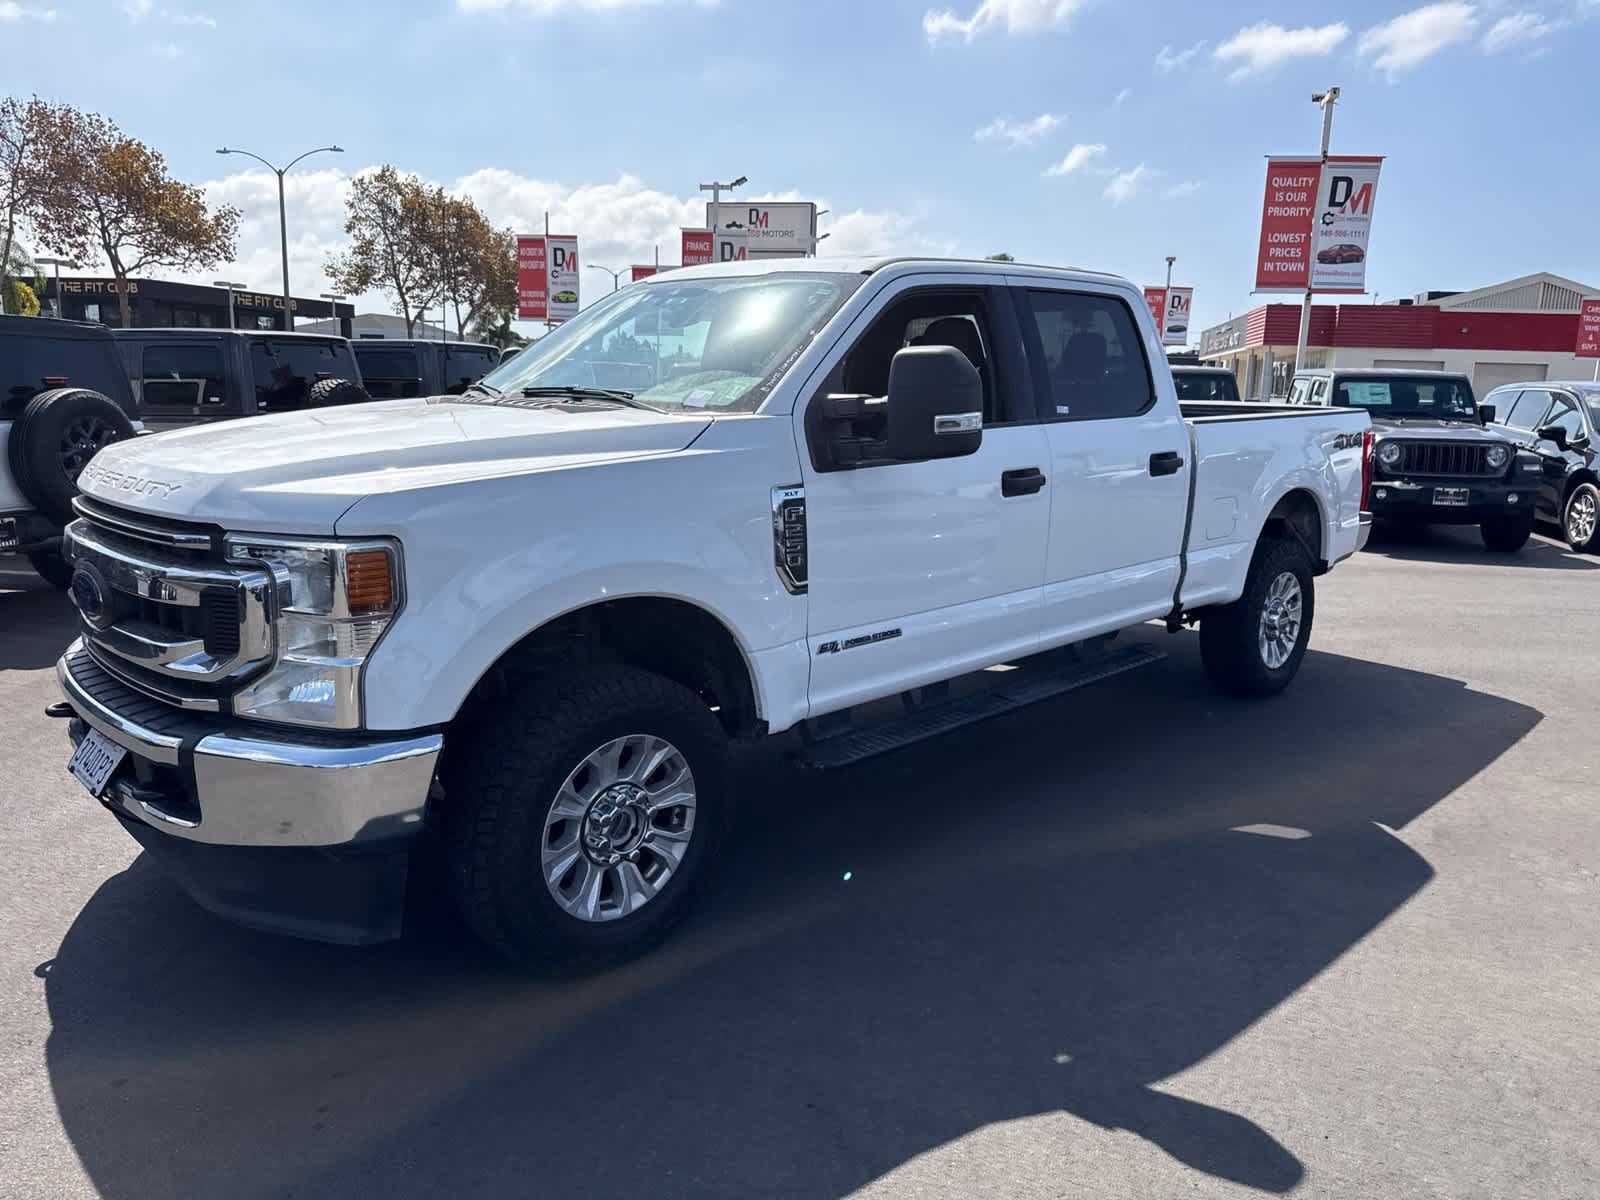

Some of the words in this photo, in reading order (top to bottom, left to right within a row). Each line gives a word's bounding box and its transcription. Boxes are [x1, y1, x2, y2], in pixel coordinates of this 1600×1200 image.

[1272, 177, 1314, 187] QUALITY
[1275, 192, 1285, 202] IS
[1286, 192, 1307, 203] OUR
[1268, 207, 1311, 217] PRIORITY
[762, 230, 795, 239] MOTORS
[1268, 233, 1306, 243] LOWEST
[1269, 248, 1302, 258] PRICES
[1264, 262, 1275, 272] IN
[1276, 262, 1305, 272] TOWN
[84, 282, 104, 293] FIT
[255, 295, 271, 307] FIT
[120, 476, 182, 498] DUTY
